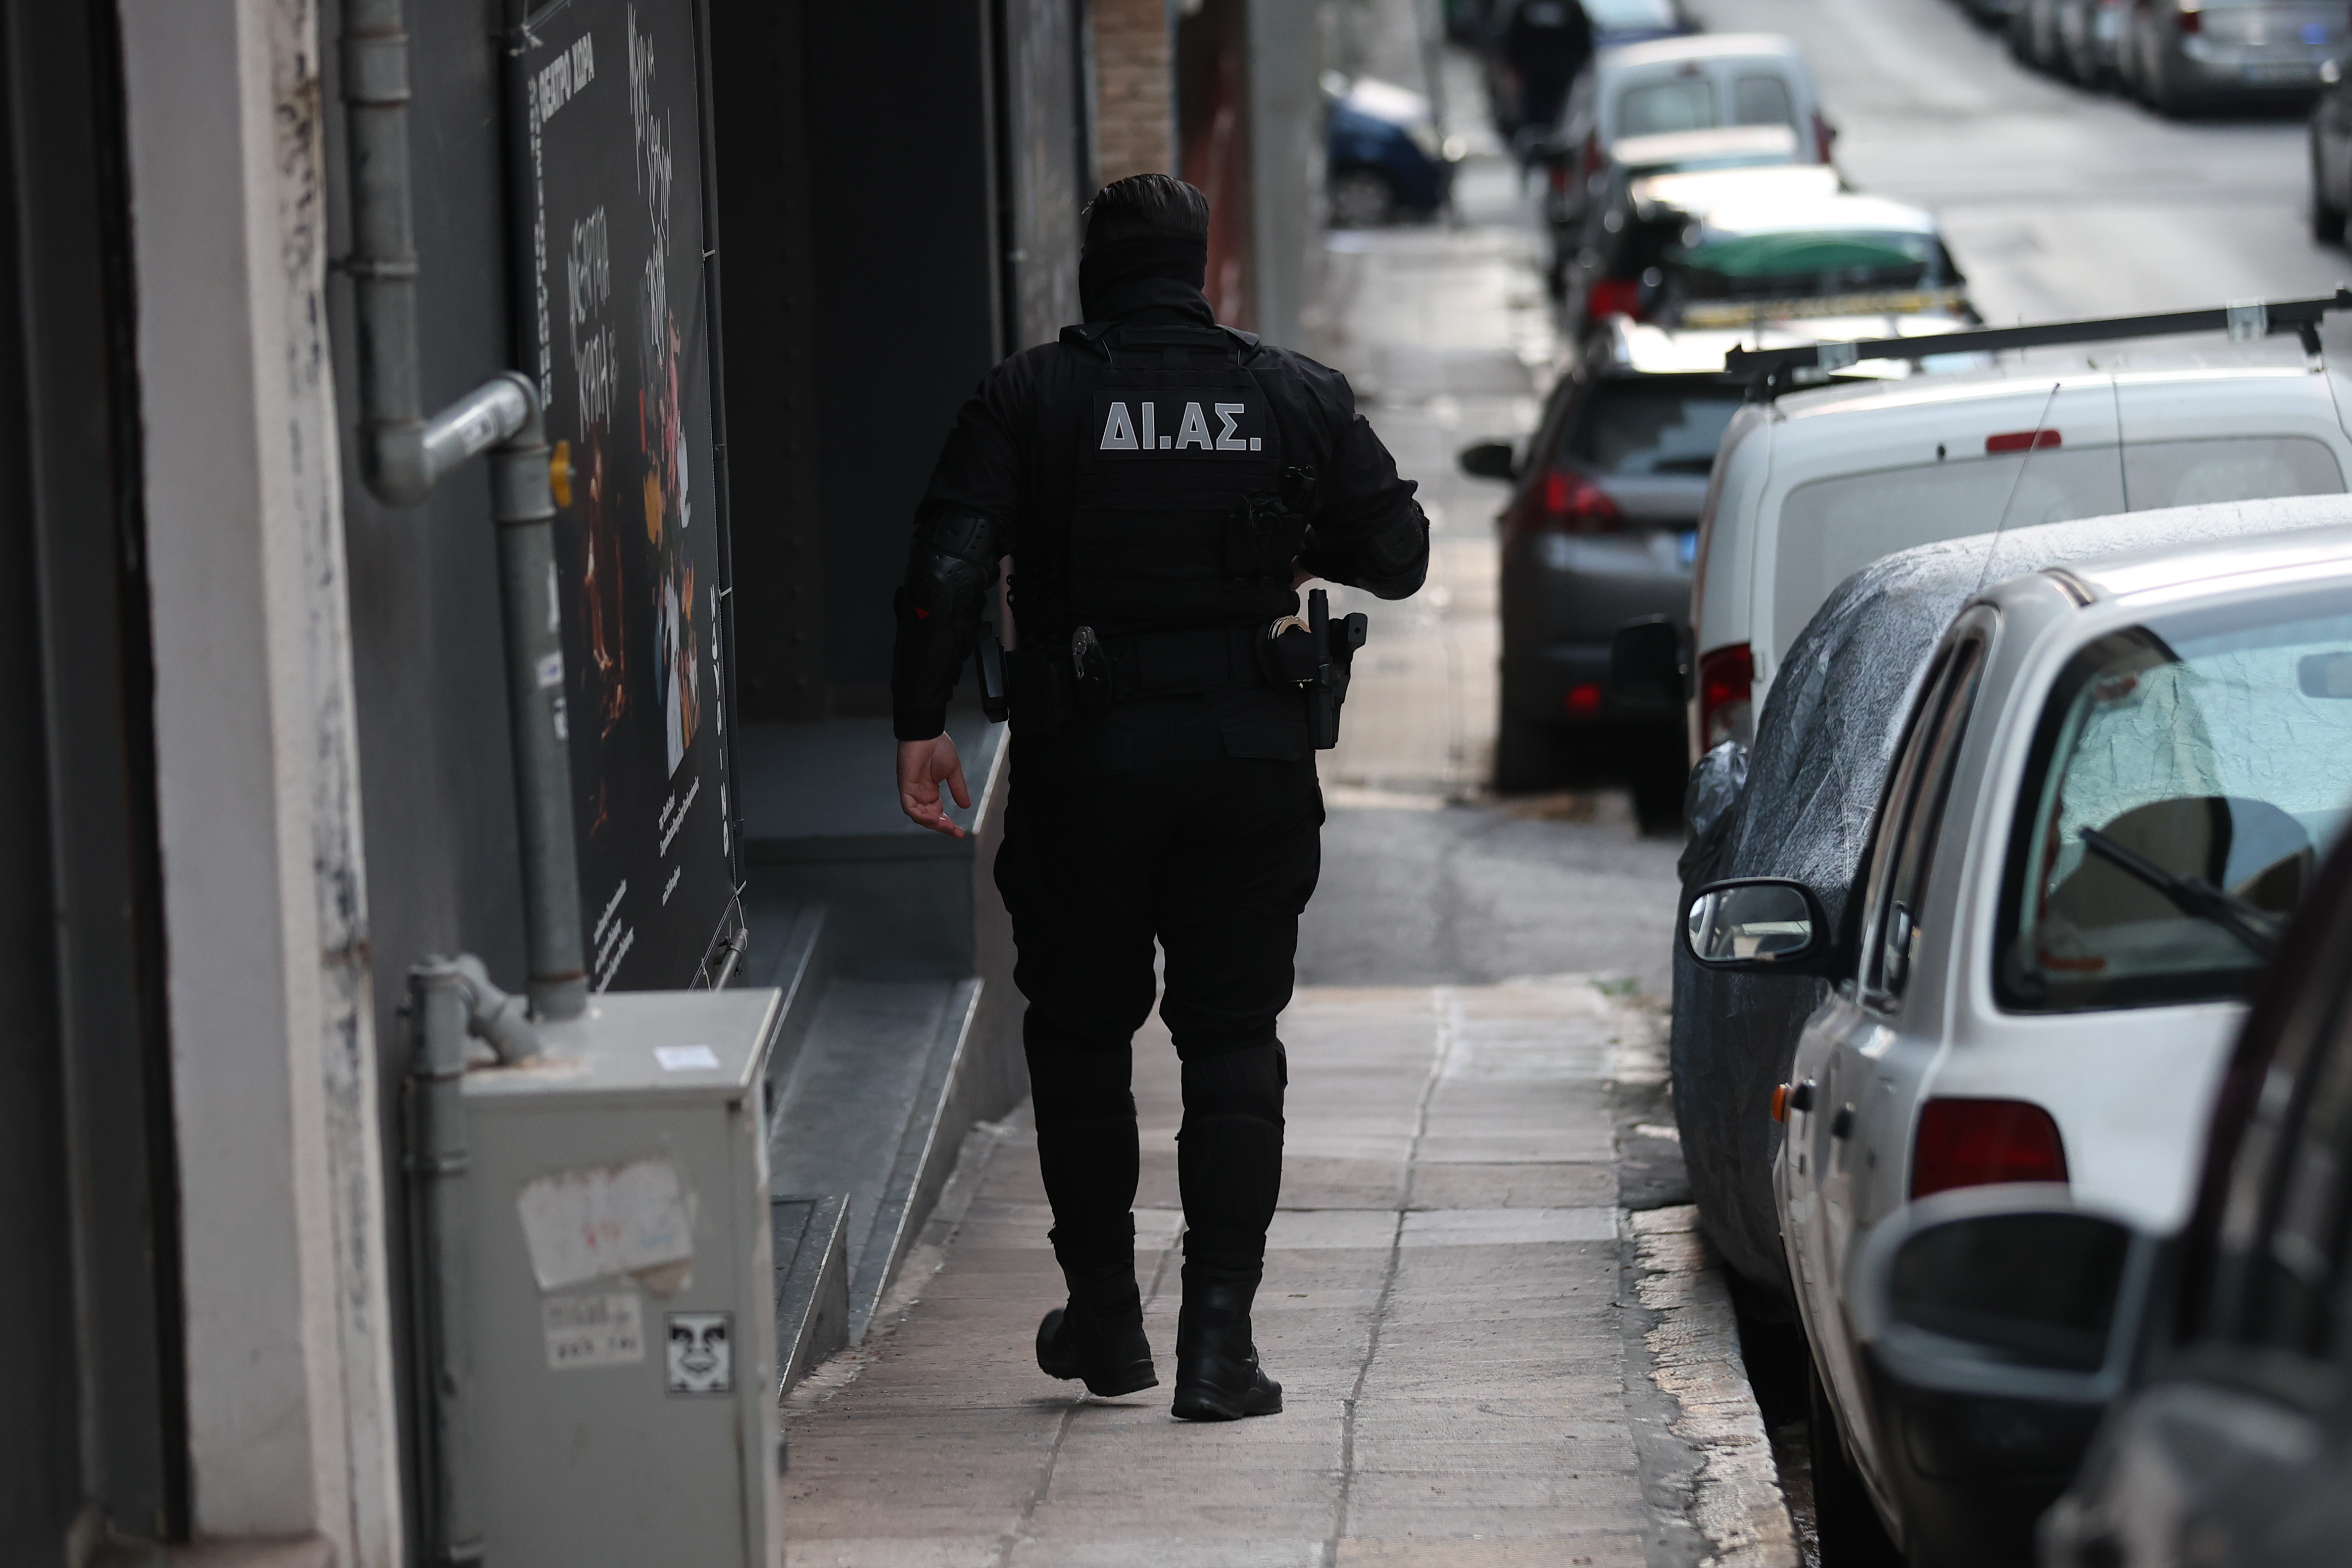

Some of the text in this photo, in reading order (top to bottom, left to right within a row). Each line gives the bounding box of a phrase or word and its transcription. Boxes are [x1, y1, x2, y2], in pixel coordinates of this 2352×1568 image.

[538, 31, 595, 123] ΘΕΑΤΡΟ ΧΩΡΑ
[1099, 402, 1262, 451] ΔΙ.ΑΣ.
